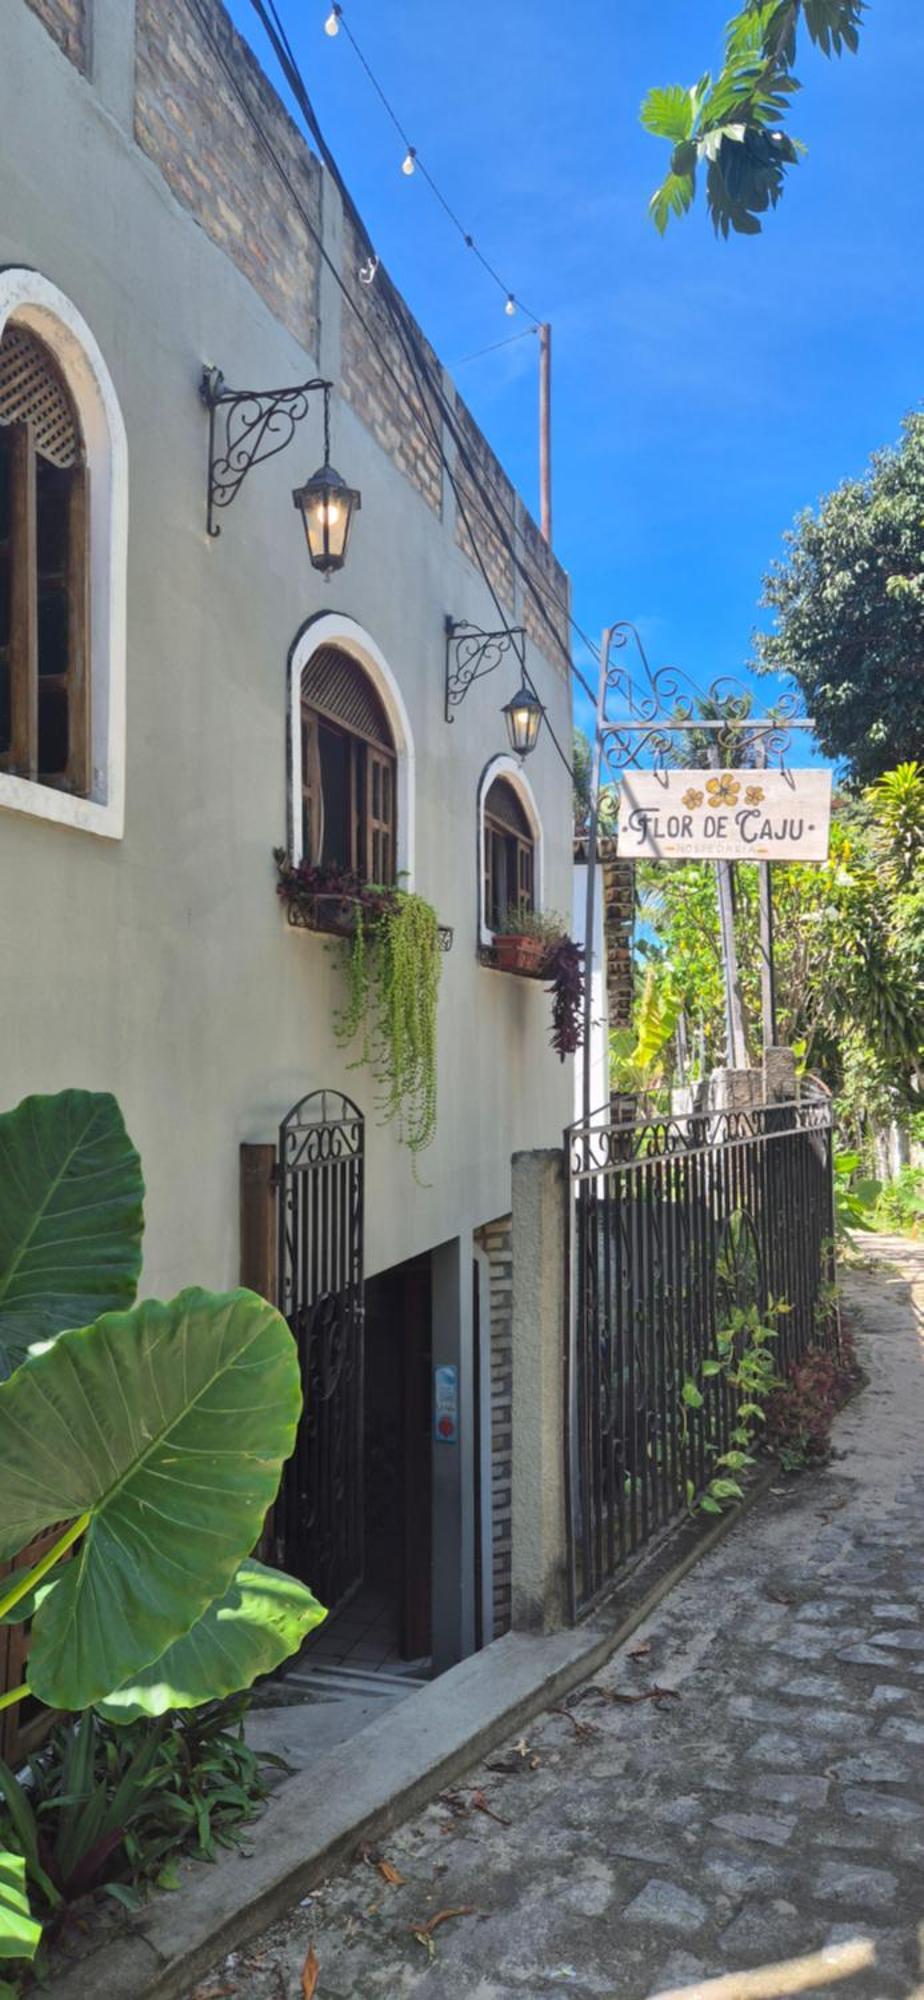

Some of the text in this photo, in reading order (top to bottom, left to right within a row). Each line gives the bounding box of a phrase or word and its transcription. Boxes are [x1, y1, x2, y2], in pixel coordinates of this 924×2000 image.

[629, 808, 804, 845] FLOR DE CAJU
